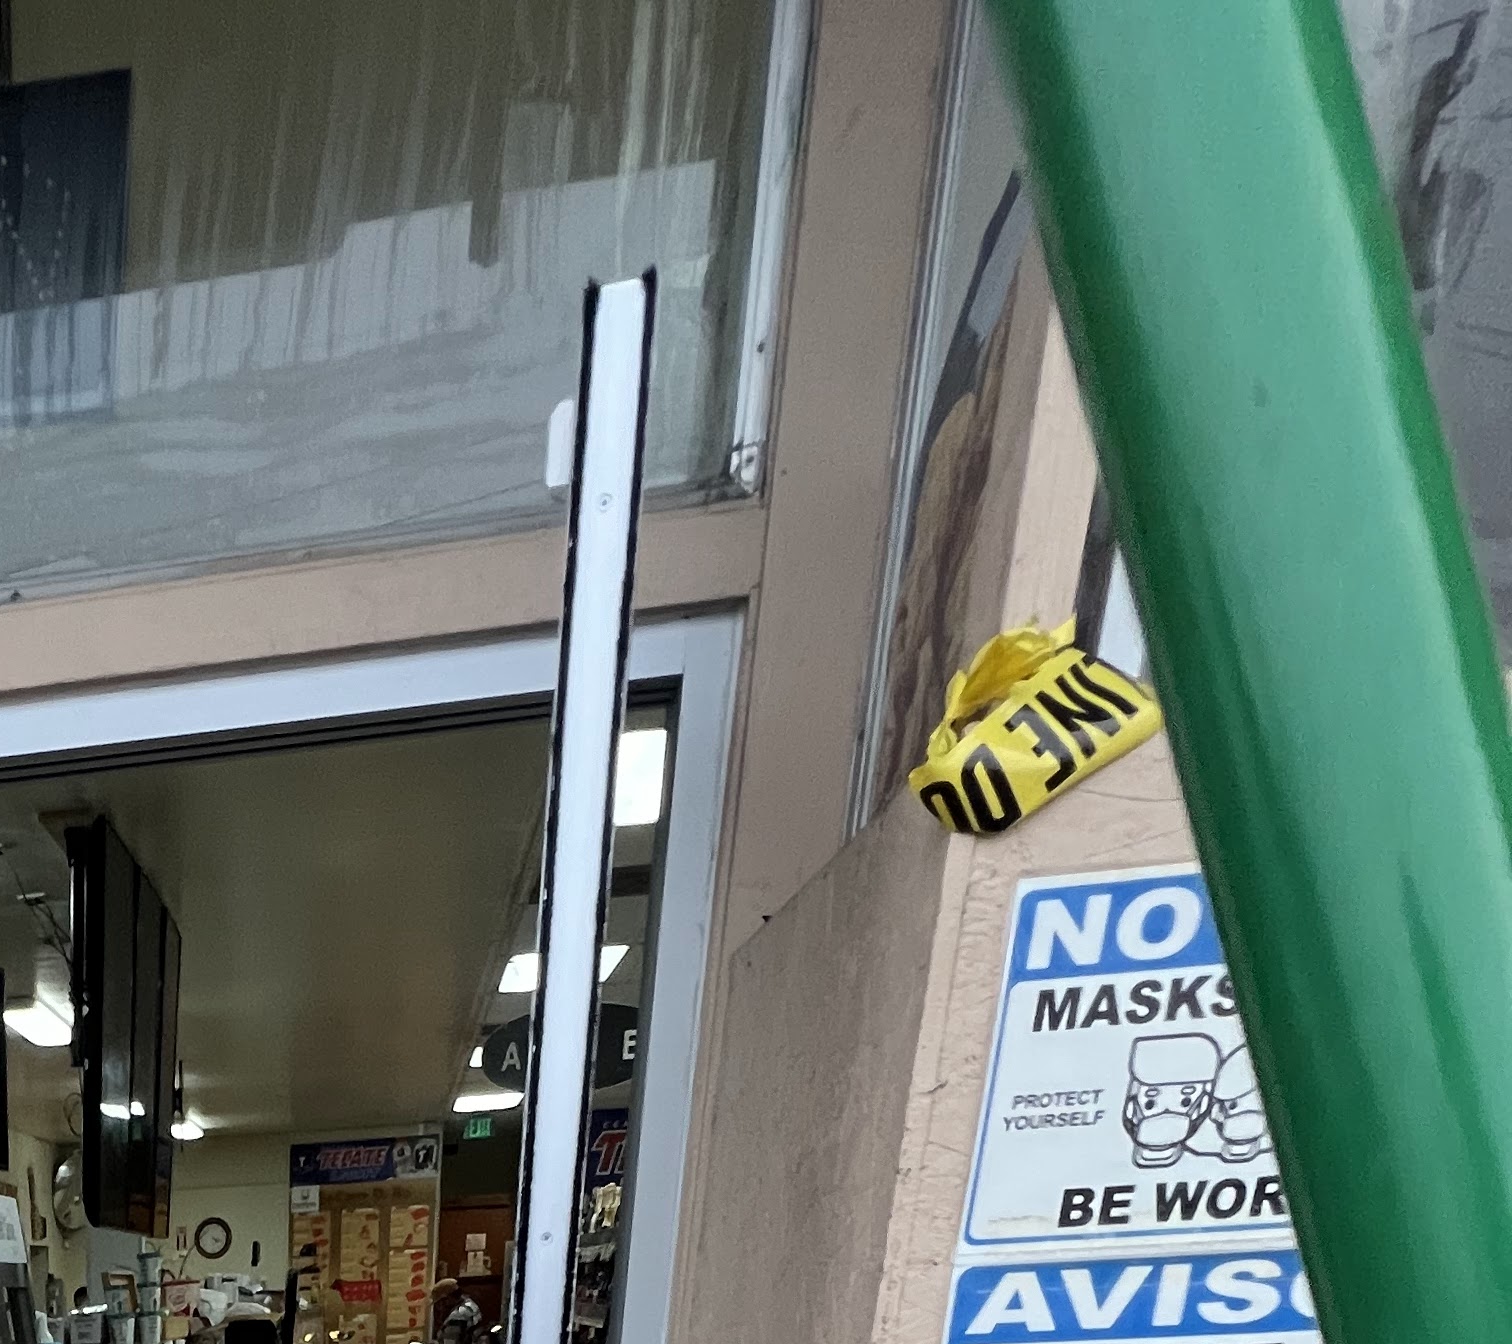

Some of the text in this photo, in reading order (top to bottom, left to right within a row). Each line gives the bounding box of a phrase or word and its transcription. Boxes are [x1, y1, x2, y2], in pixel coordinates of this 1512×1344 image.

[1004, 655, 1140, 792] INE
[1026, 887, 1203, 970] NO
[1011, 1088, 1105, 1110] PROTECT
[1003, 1110, 1106, 1132] YOURSELF
[316, 1145, 391, 1170] TECATE
[1058, 1185, 1136, 1227] BE
[964, 1258, 1316, 1336] AVIS
